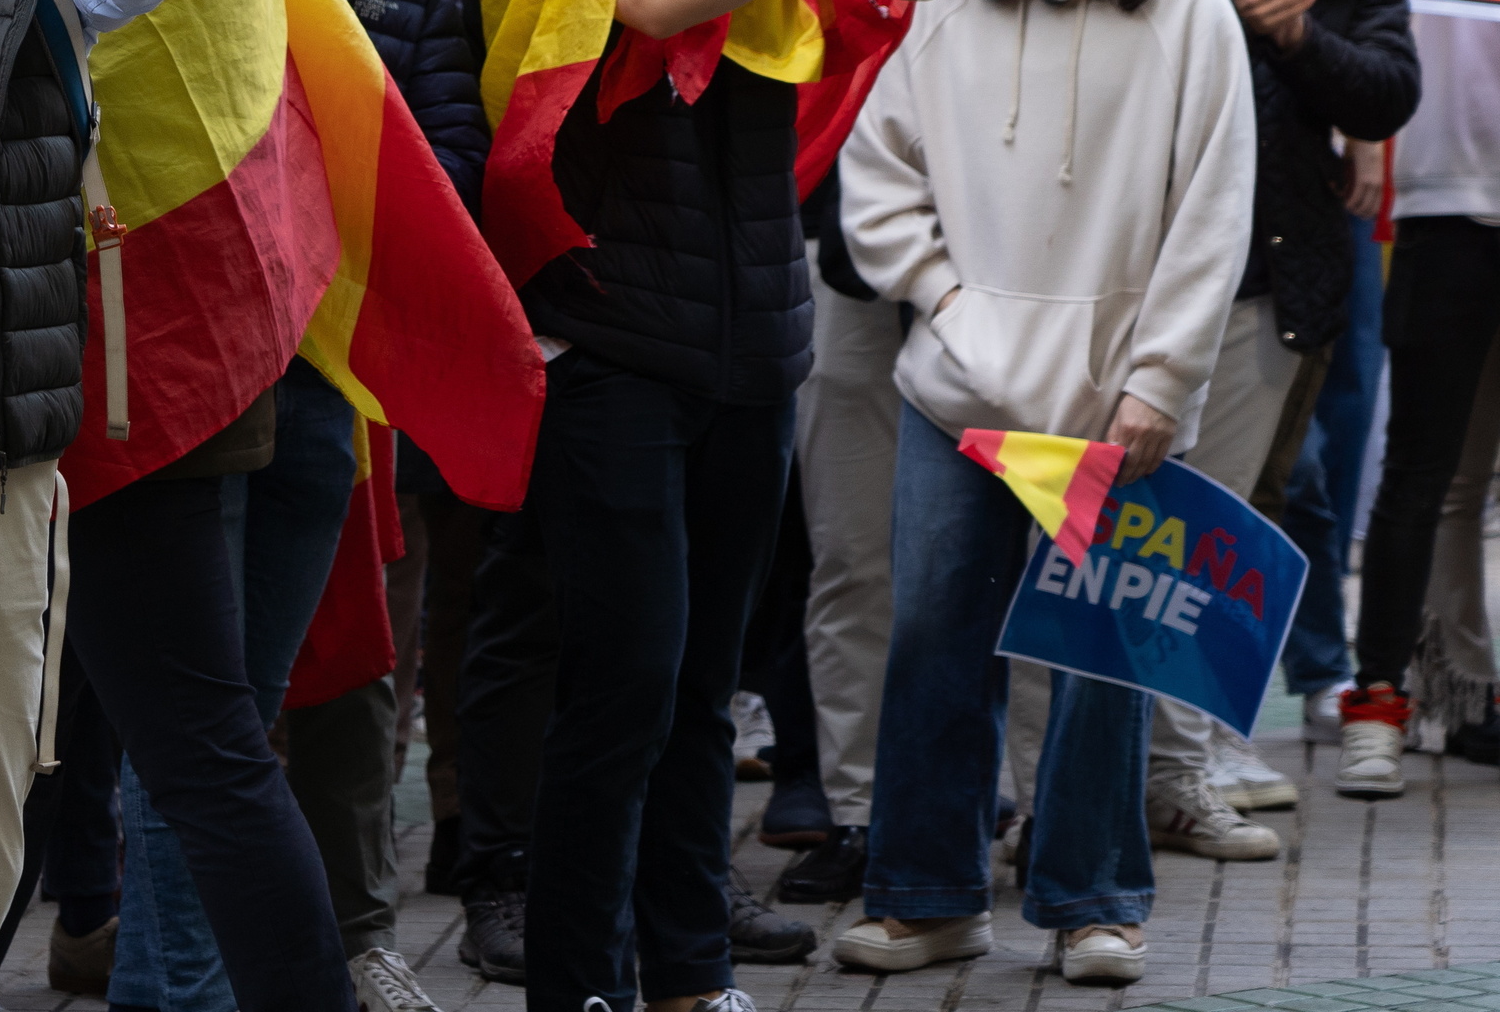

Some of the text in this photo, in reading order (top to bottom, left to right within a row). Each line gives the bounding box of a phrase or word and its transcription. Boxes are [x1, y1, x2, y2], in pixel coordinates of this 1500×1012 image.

[1035, 544, 1212, 636] EN PIE
[1090, 497, 1264, 621] SPAÑA
